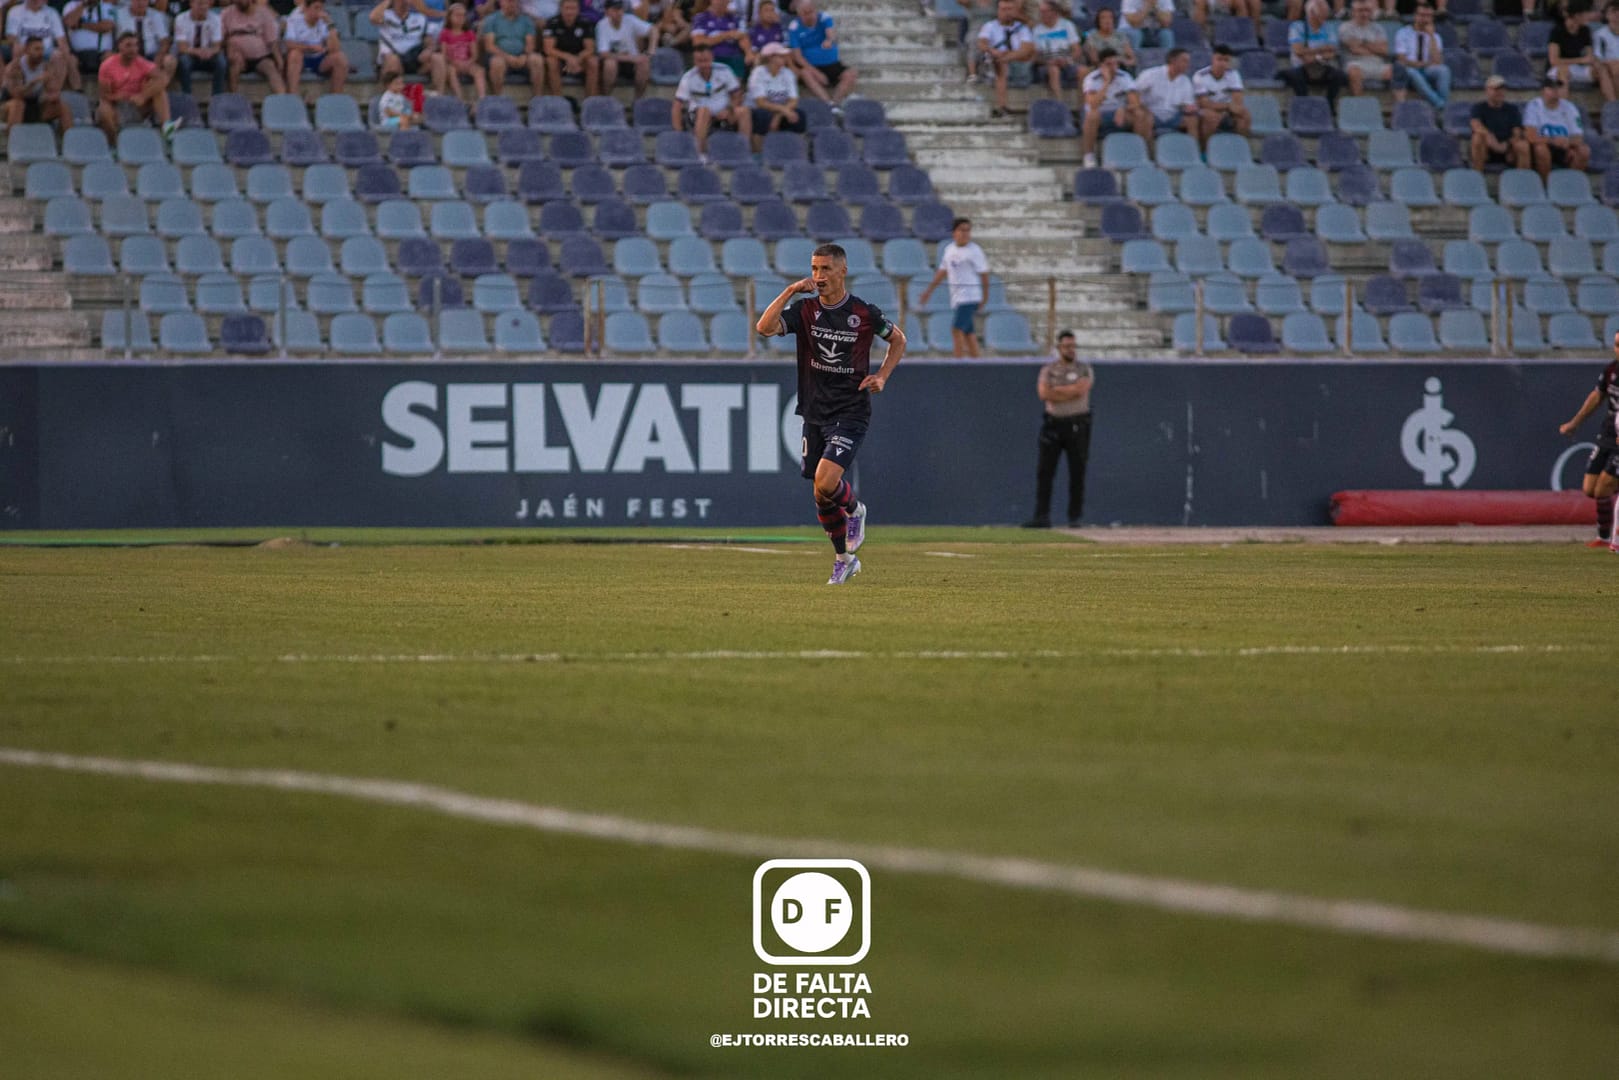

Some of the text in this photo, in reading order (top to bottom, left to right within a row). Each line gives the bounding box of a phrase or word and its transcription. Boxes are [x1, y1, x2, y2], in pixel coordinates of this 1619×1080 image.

[823, 333, 858, 343] MAVEN
[810, 358, 855, 374] Extremadura
[516, 493, 711, 519] JAÉN FEST
